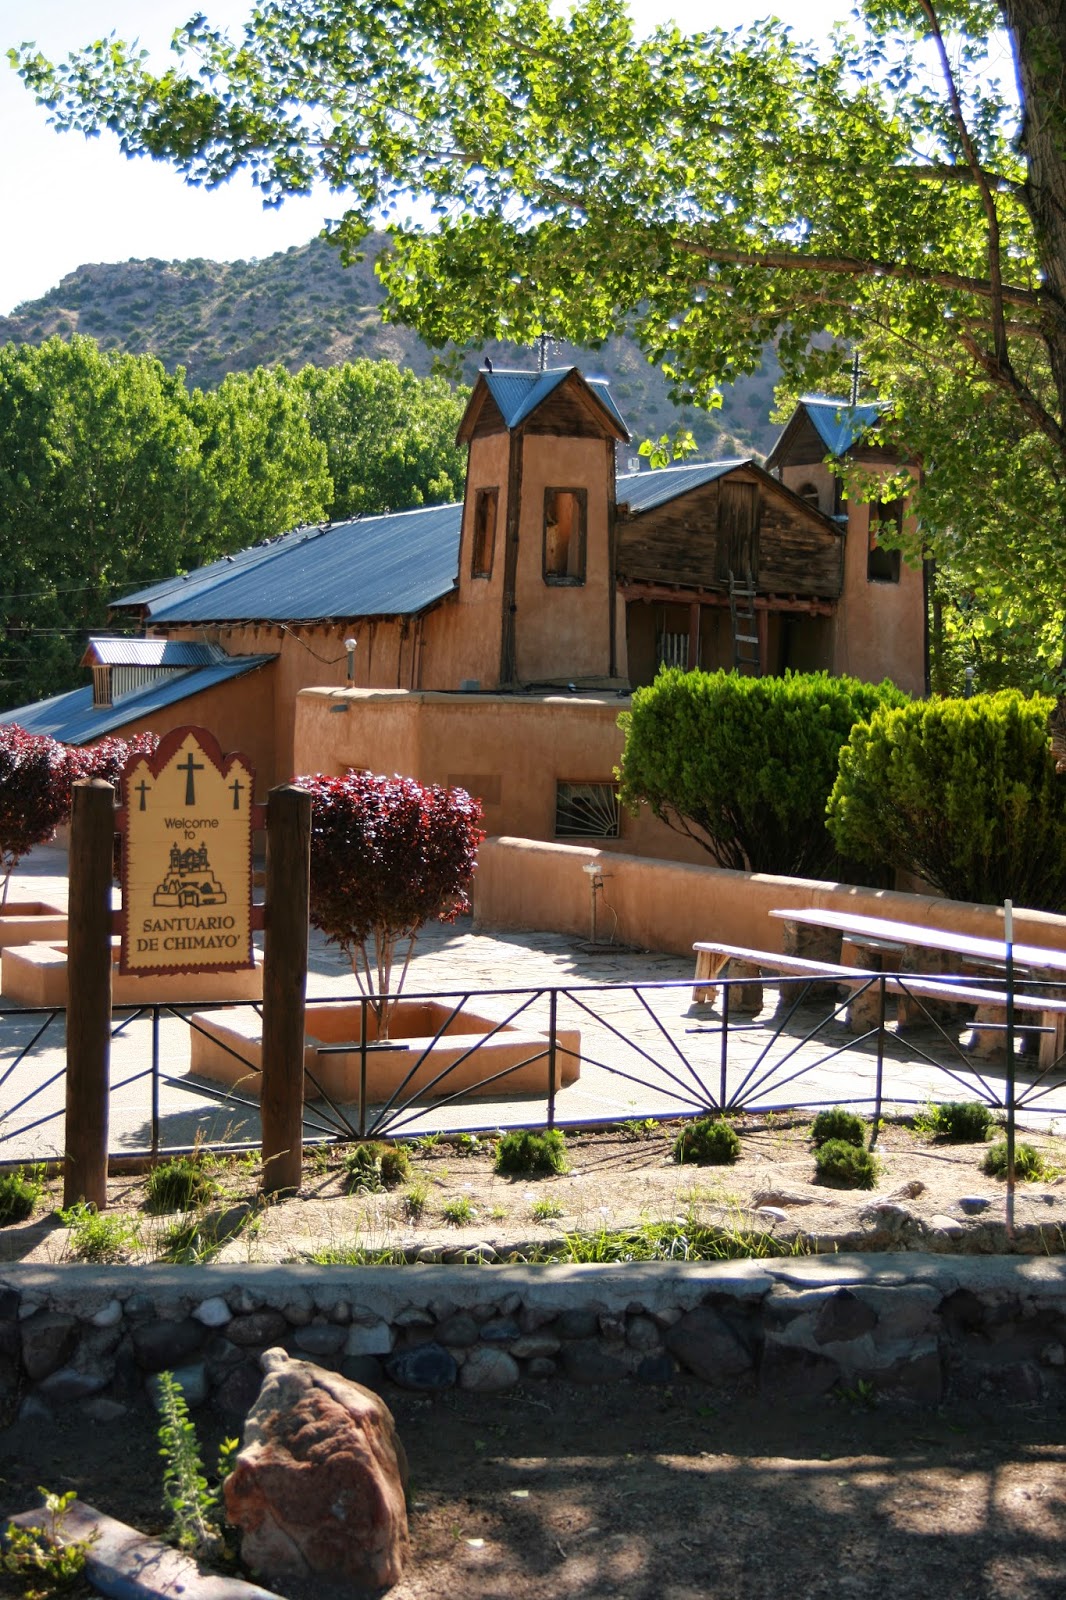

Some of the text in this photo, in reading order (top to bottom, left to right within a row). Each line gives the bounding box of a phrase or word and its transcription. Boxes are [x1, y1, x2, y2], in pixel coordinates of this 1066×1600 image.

[164, 818, 219, 829] Welcome
[184, 829, 196, 840] to
[143, 916, 235, 933] SANTUARIO
[137, 938, 159, 952] DE
